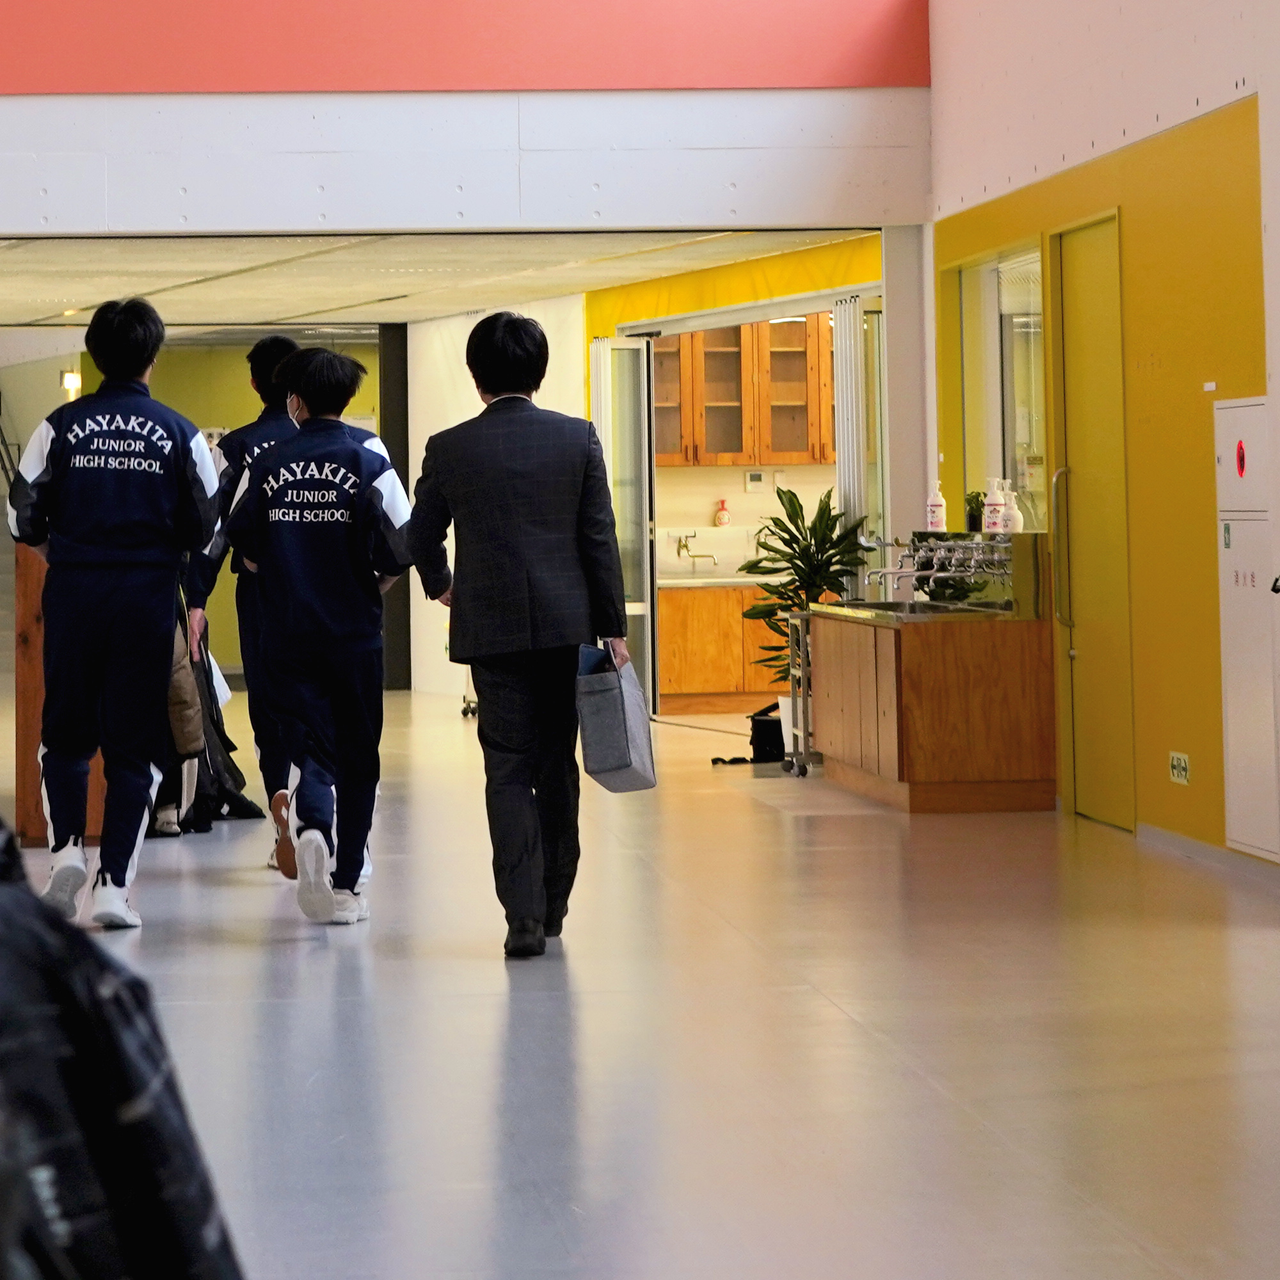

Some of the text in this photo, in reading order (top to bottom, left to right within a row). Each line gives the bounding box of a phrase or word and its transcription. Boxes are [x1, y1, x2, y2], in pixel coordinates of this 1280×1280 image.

[66, 413, 173, 456] HAYAKITA
[90, 437, 145, 453] JUNIOR
[70, 454, 164, 474] HIGH SCHOOL
[284, 489, 338, 503] JUNIOR
[269, 508, 352, 523] HIGH SCHOOL
